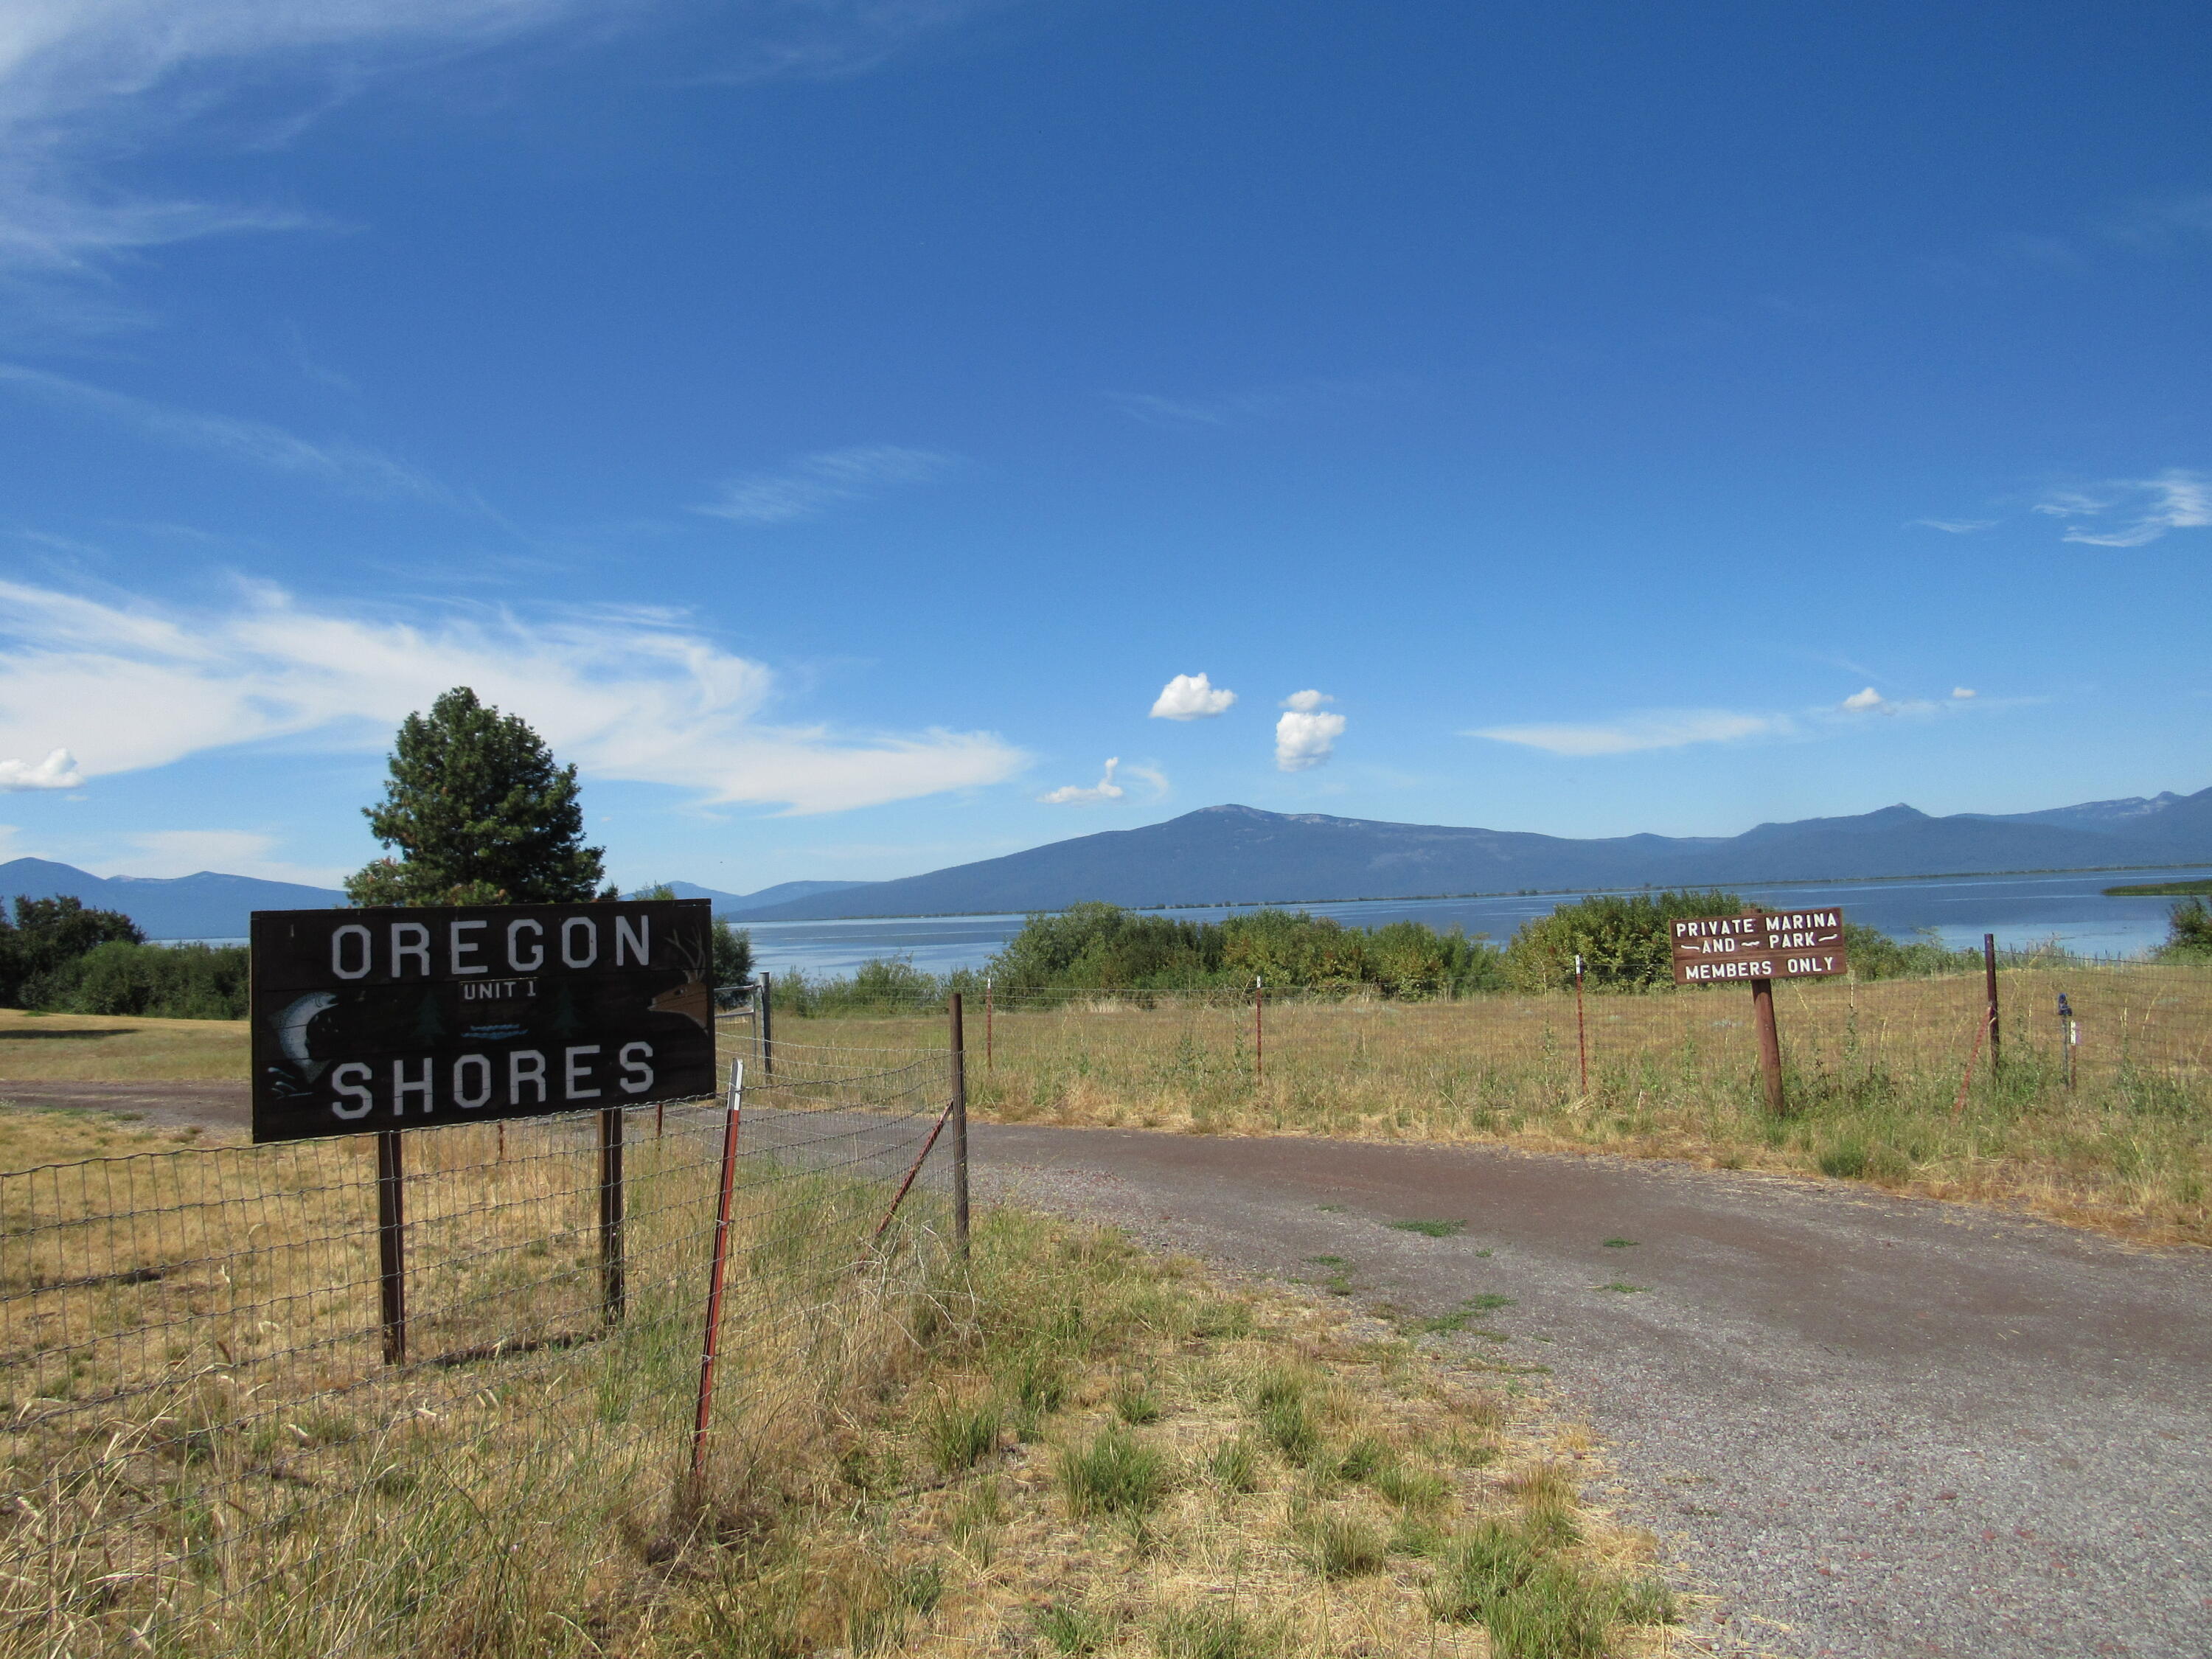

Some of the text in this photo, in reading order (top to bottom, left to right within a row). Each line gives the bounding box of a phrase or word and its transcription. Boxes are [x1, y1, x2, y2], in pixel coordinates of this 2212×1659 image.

[1675, 913, 1837, 937] PRIVATE MARINA
[332, 914, 650, 980] OREGON
[1702, 931, 1815, 954] AND PARK
[1686, 956, 1833, 980] MEMBERS ONLY
[464, 981, 517, 1000] UNIT
[332, 1041, 654, 1120] SHORES
